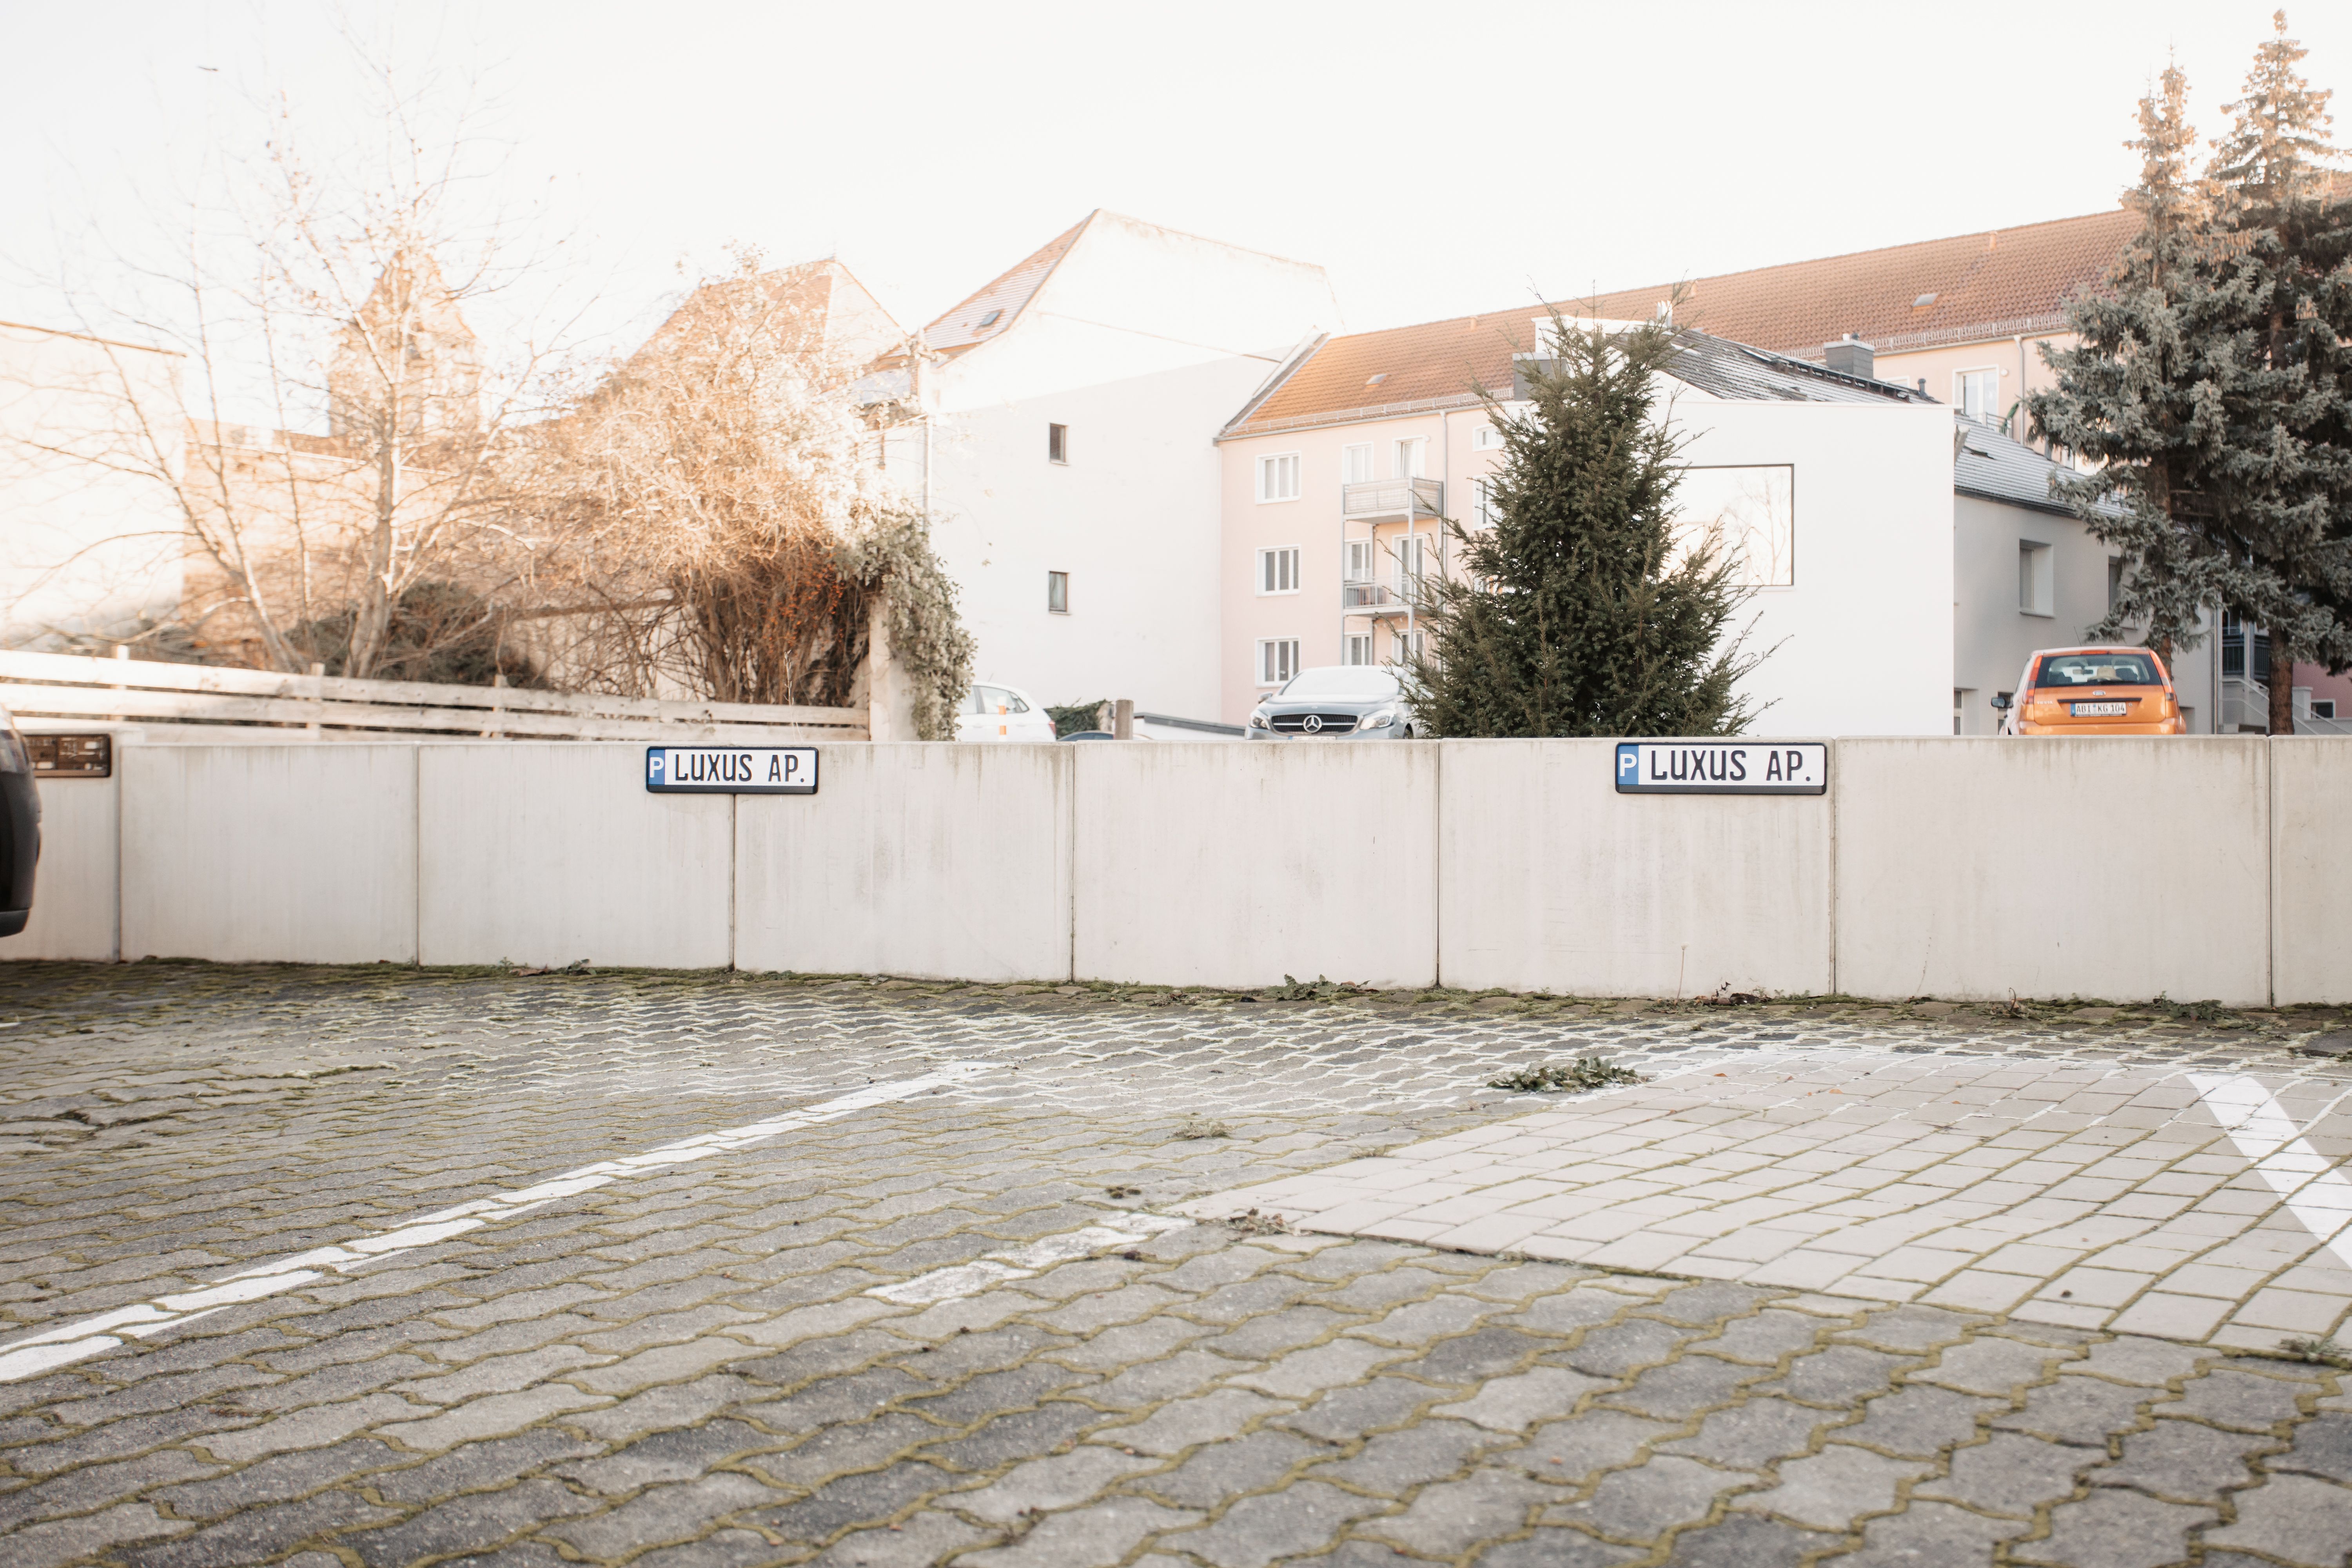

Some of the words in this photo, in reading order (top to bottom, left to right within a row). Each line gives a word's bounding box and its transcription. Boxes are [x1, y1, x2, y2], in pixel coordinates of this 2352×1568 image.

[649, 757, 664, 778] P
[675, 754, 752, 782] LUXUS
[768, 754, 805, 782] AP.
[1620, 753, 1637, 777] P
[1651, 750, 1746, 781] LUXUS
[1766, 750, 1811, 782] AP.
